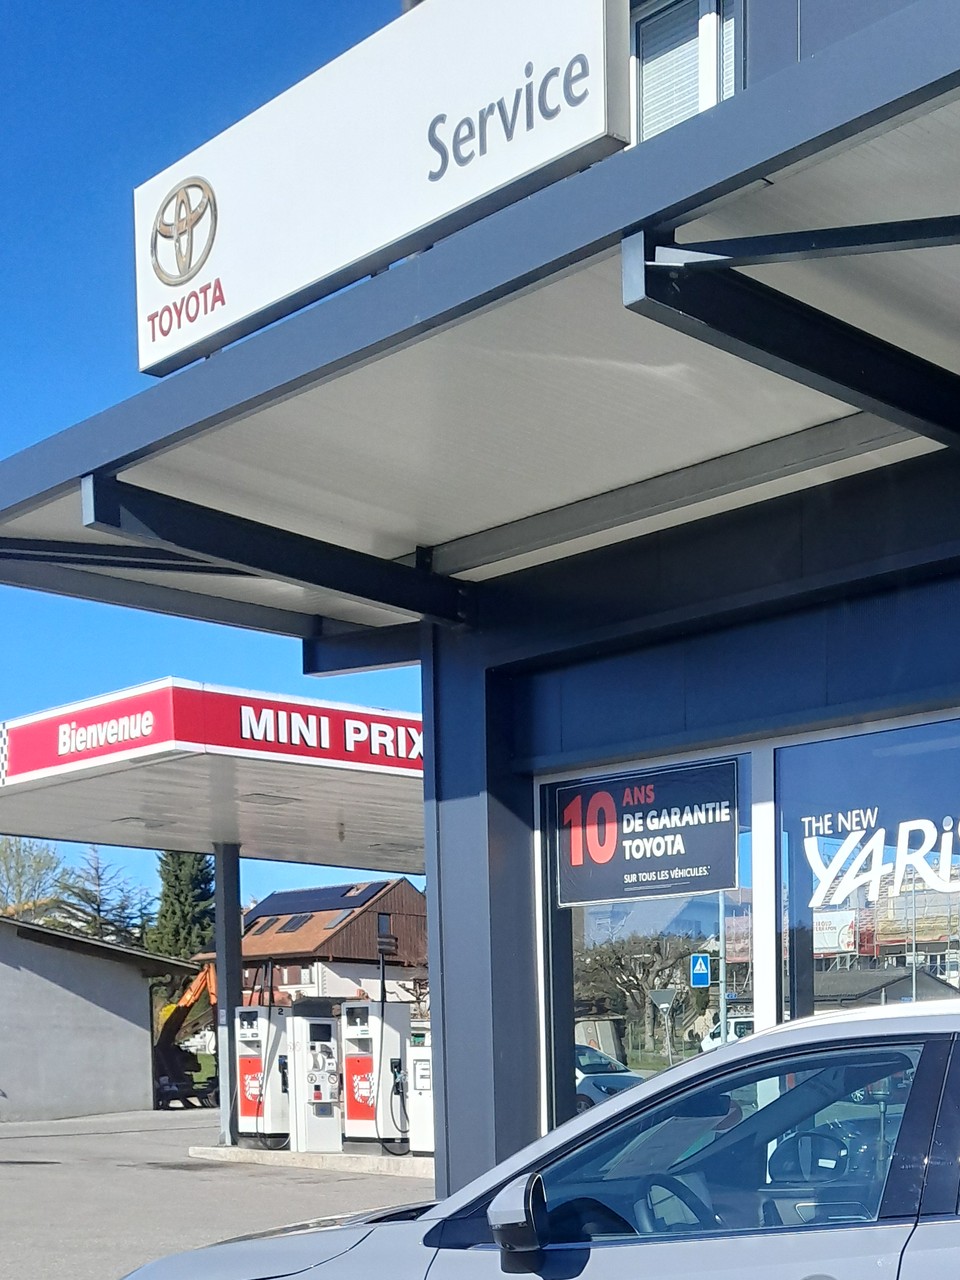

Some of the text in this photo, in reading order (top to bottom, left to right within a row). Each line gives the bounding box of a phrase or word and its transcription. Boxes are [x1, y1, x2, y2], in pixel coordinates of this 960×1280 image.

[427, 52, 590, 182] Service
[147, 277, 226, 343] TOYOTA
[58, 710, 154, 756] Bienvenue
[240, 705, 423, 760] MINI PRIX
[622, 784, 655, 807] ANS
[563, 791, 618, 867] 10
[622, 801, 731, 834] DE GARANTIE
[801, 806, 879, 837] THE NEW
[622, 833, 686, 861] TOYOTA
[623, 873, 638, 884] SUR
[638, 871, 657, 882] TOUS
[657, 870, 670, 880] LES
[278, 1008, 284, 1016] 2
